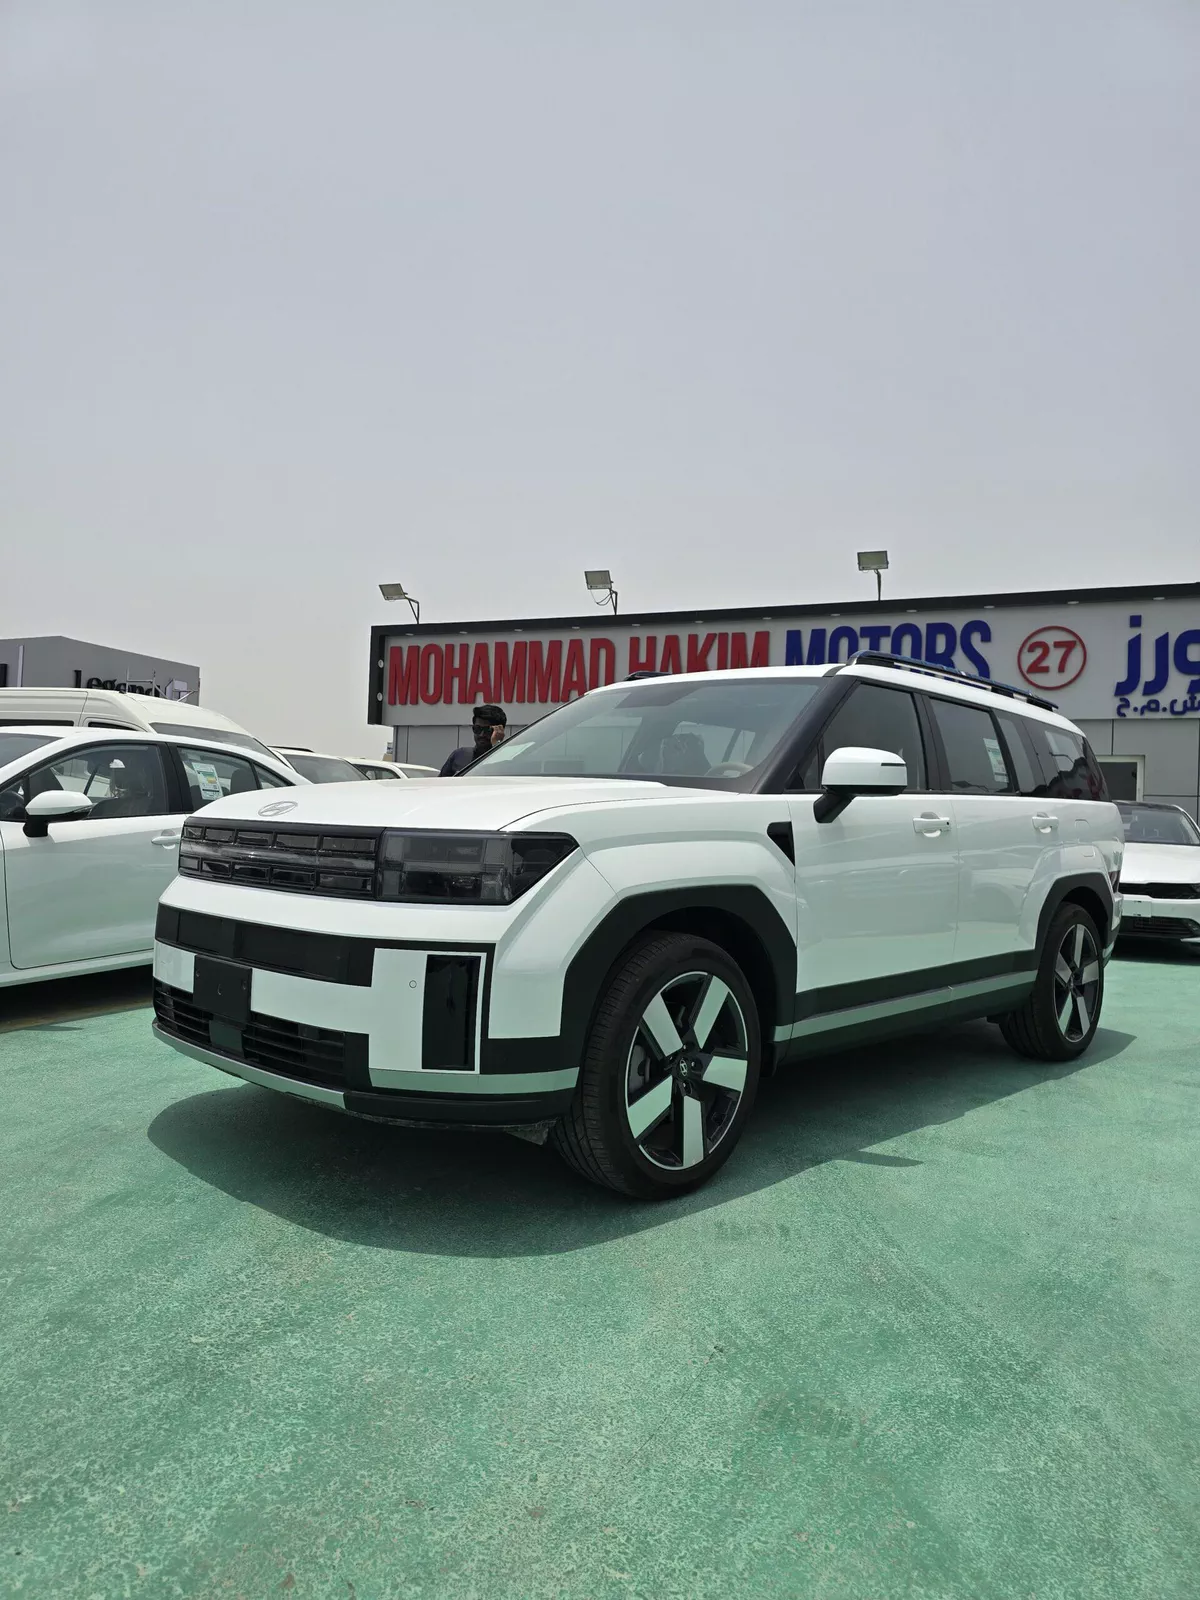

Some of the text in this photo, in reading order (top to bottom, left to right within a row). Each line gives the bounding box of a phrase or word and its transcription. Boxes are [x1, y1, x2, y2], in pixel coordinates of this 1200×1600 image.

[387, 620, 992, 706] MOHAMMAD HAKIM MOTORS
[1026, 640, 1077, 674] 27
